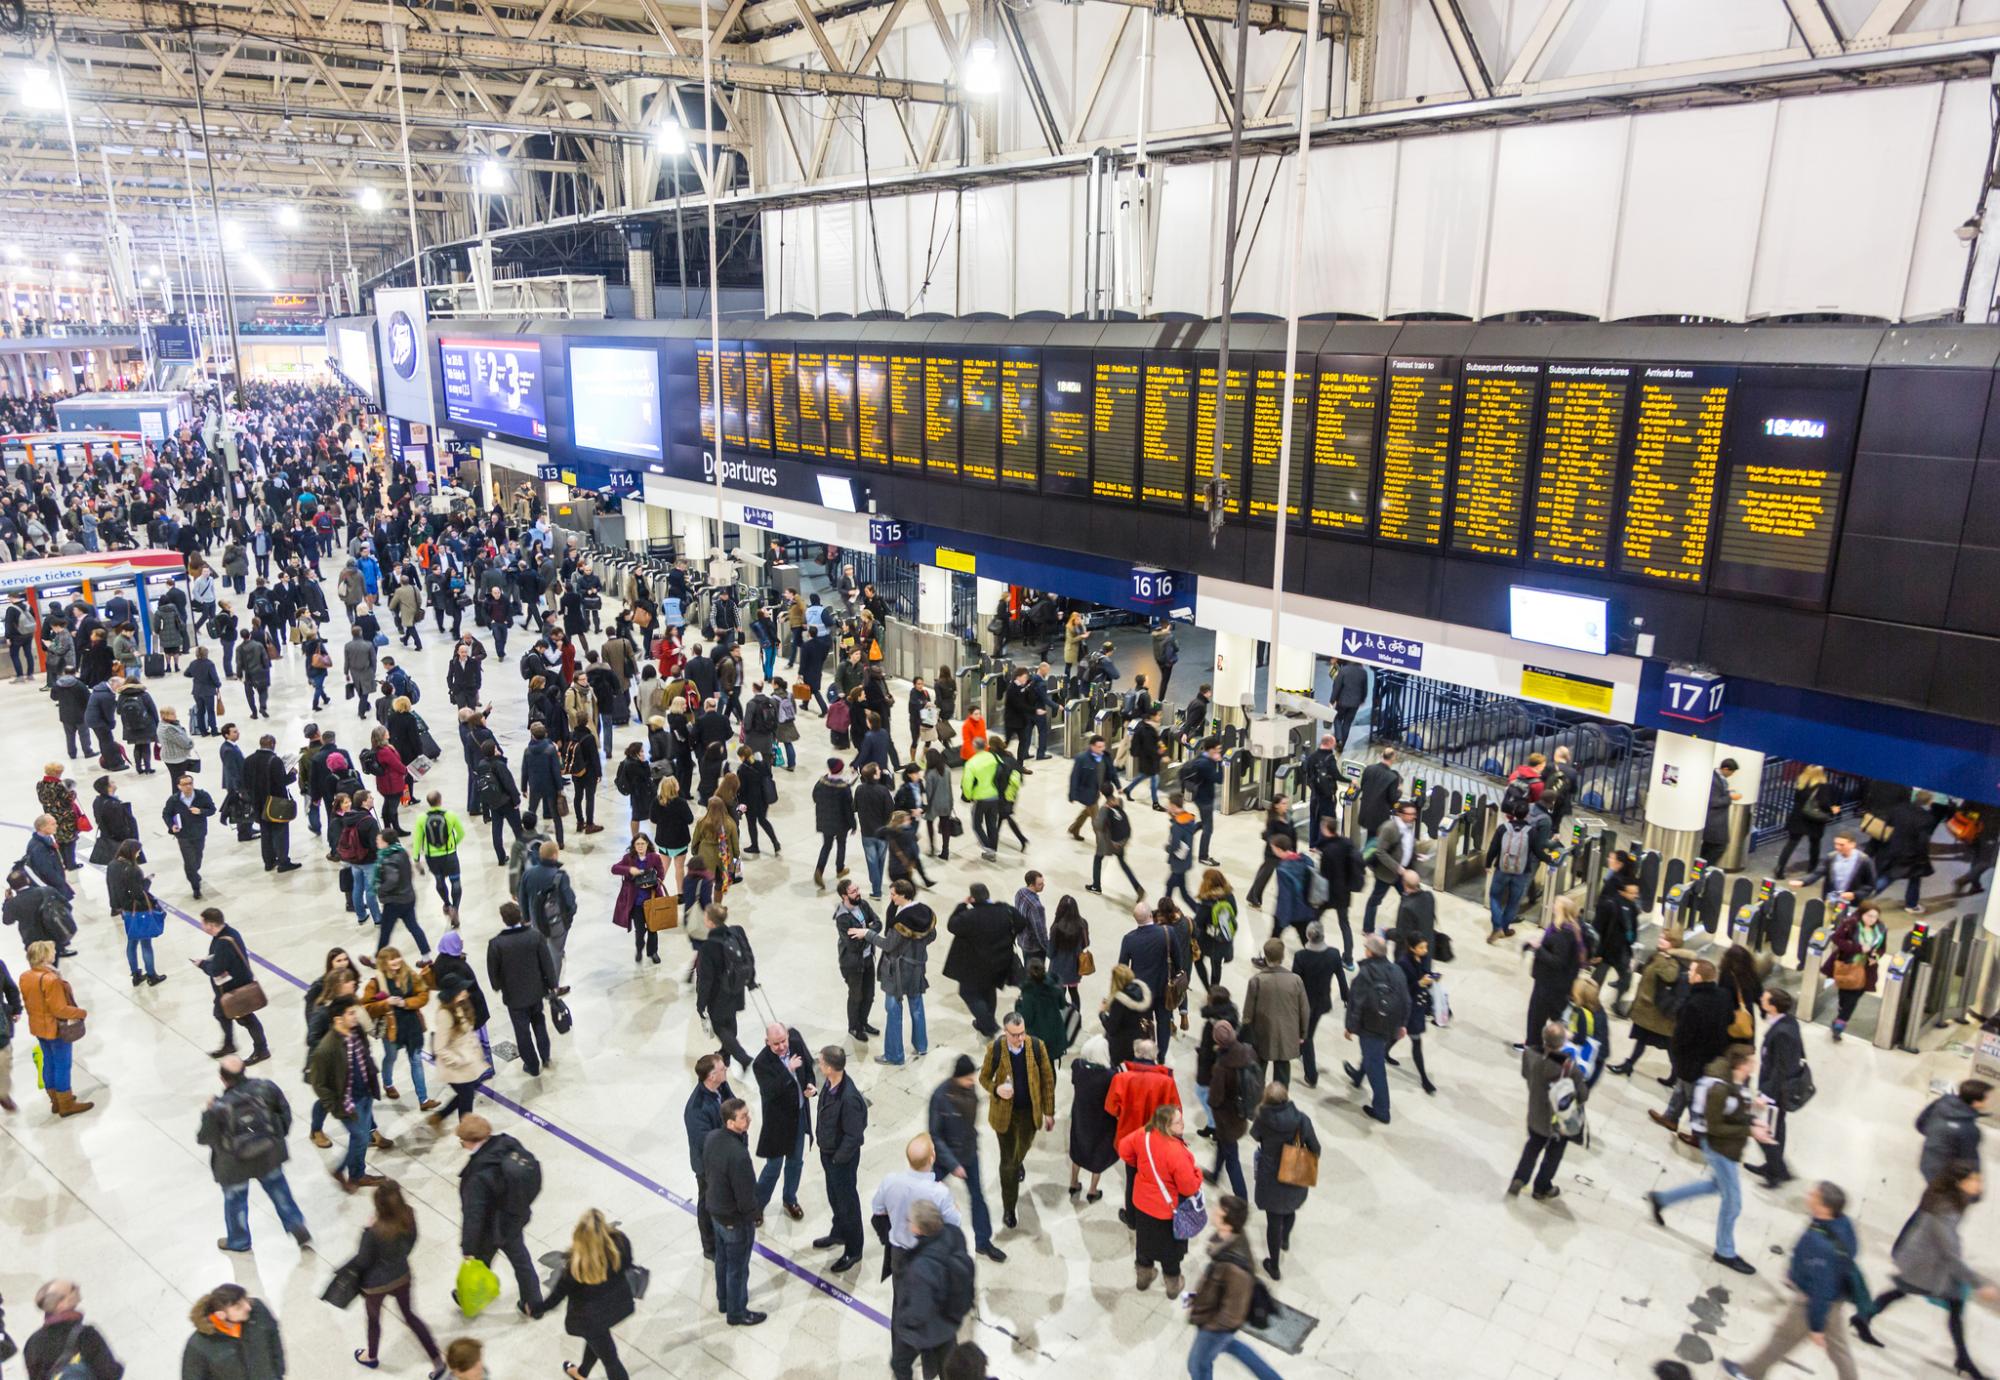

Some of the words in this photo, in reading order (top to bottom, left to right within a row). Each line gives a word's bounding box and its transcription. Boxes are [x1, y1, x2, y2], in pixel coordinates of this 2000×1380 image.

[1392, 361, 1413, 369] Fastest
[1466, 363, 1503, 372] Subsequent
[1504, 364, 1538, 373] departures
[487, 352, 499, 393] 2
[1549, 366, 1590, 375] Subsequent
[1591, 367, 1629, 376] departures
[1645, 368, 1674, 377] Arrivals
[1675, 369, 1693, 378] from
[505, 353, 520, 410] 3
[1146, 376, 1175, 384] Strawberry
[1321, 373, 1339, 381] 1900
[1343, 374, 1368, 383] Platform
[1257, 380, 1275, 389] Epsom
[1319, 383, 1357, 392] Portsmouth
[1358, 385, 1371, 393] Hbr
[368, 405, 377, 413] 11
[450, 442, 461, 452] 12
[545, 467, 558, 480] 13
[1746, 465, 1766, 474] Major
[1768, 467, 1807, 477] Engineering
[1808, 470, 1827, 478] Work
[619, 473, 634, 486] 14
[1749, 474, 1780, 484] Saturday
[1781, 477, 1797, 485] 21st
[1799, 479, 1822, 487] March
[1142, 487, 1155, 495] South
[1156, 489, 1167, 497] West
[1168, 490, 1182, 499] Trains
[1746, 490, 1767, 499] There
[1792, 496, 1821, 504] planned
[1250, 501, 1265, 509] South
[1760, 502, 1799, 511] engineering
[1311, 509, 1327, 518] South
[1328, 511, 1343, 520] West
[1345, 513, 1363, 523] Trains
[1747, 507, 1769, 517] taking
[1769, 510, 1789, 518] place
[1742, 516, 1775, 526] affecting
[1776, 519, 1797, 527] South
[1797, 521, 1815, 529] West
[871, 524, 883, 541] 15
[886, 524, 902, 541] 15
[1750, 524, 1772, 533] Trains
[1472, 544, 1490, 552] Page
[1553, 554, 1574, 563] Page
[1644, 567, 1667, 576] Page
[1, 574, 41, 586] service
[45, 570, 83, 581] tickets
[1133, 575, 1151, 597] 16
[1156, 576, 1172, 597] 16
[1378, 653, 1392, 661] Wide
[1669, 682, 1703, 711] 17
[1709, 683, 1726, 712] 17
